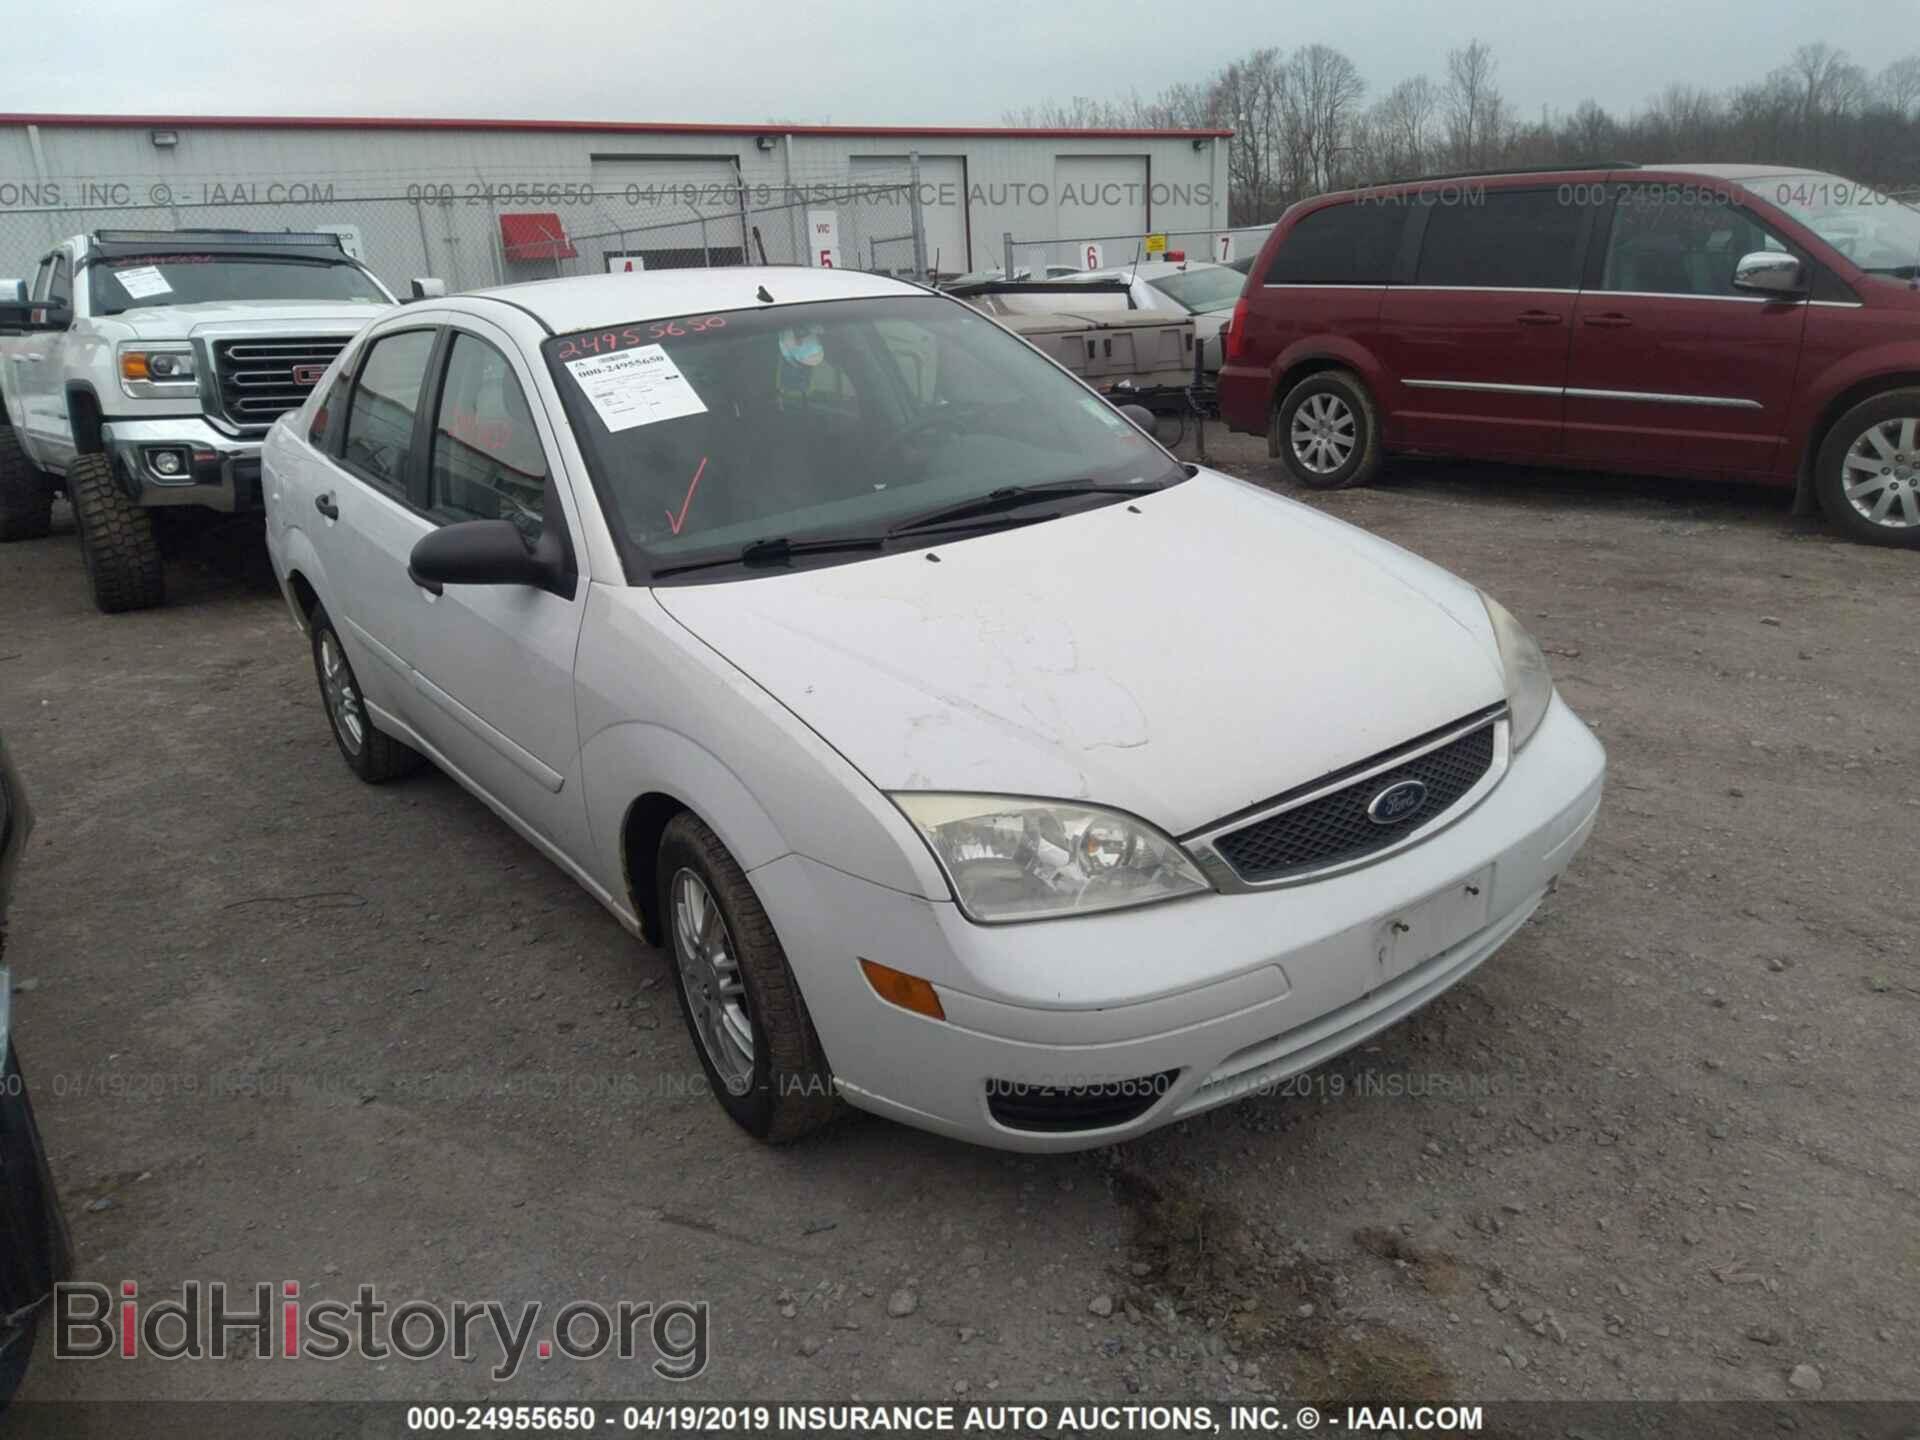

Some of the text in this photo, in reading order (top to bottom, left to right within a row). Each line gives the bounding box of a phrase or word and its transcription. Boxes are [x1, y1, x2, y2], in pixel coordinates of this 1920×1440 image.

[816, 223, 831, 234] VIC
[820, 249, 833, 269] 5
[1087, 245, 1098, 271] 6
[1221, 237, 1230, 261] 7
[558, 316, 727, 360] 24955650
[578, 355, 665, 379] 000-24955650
